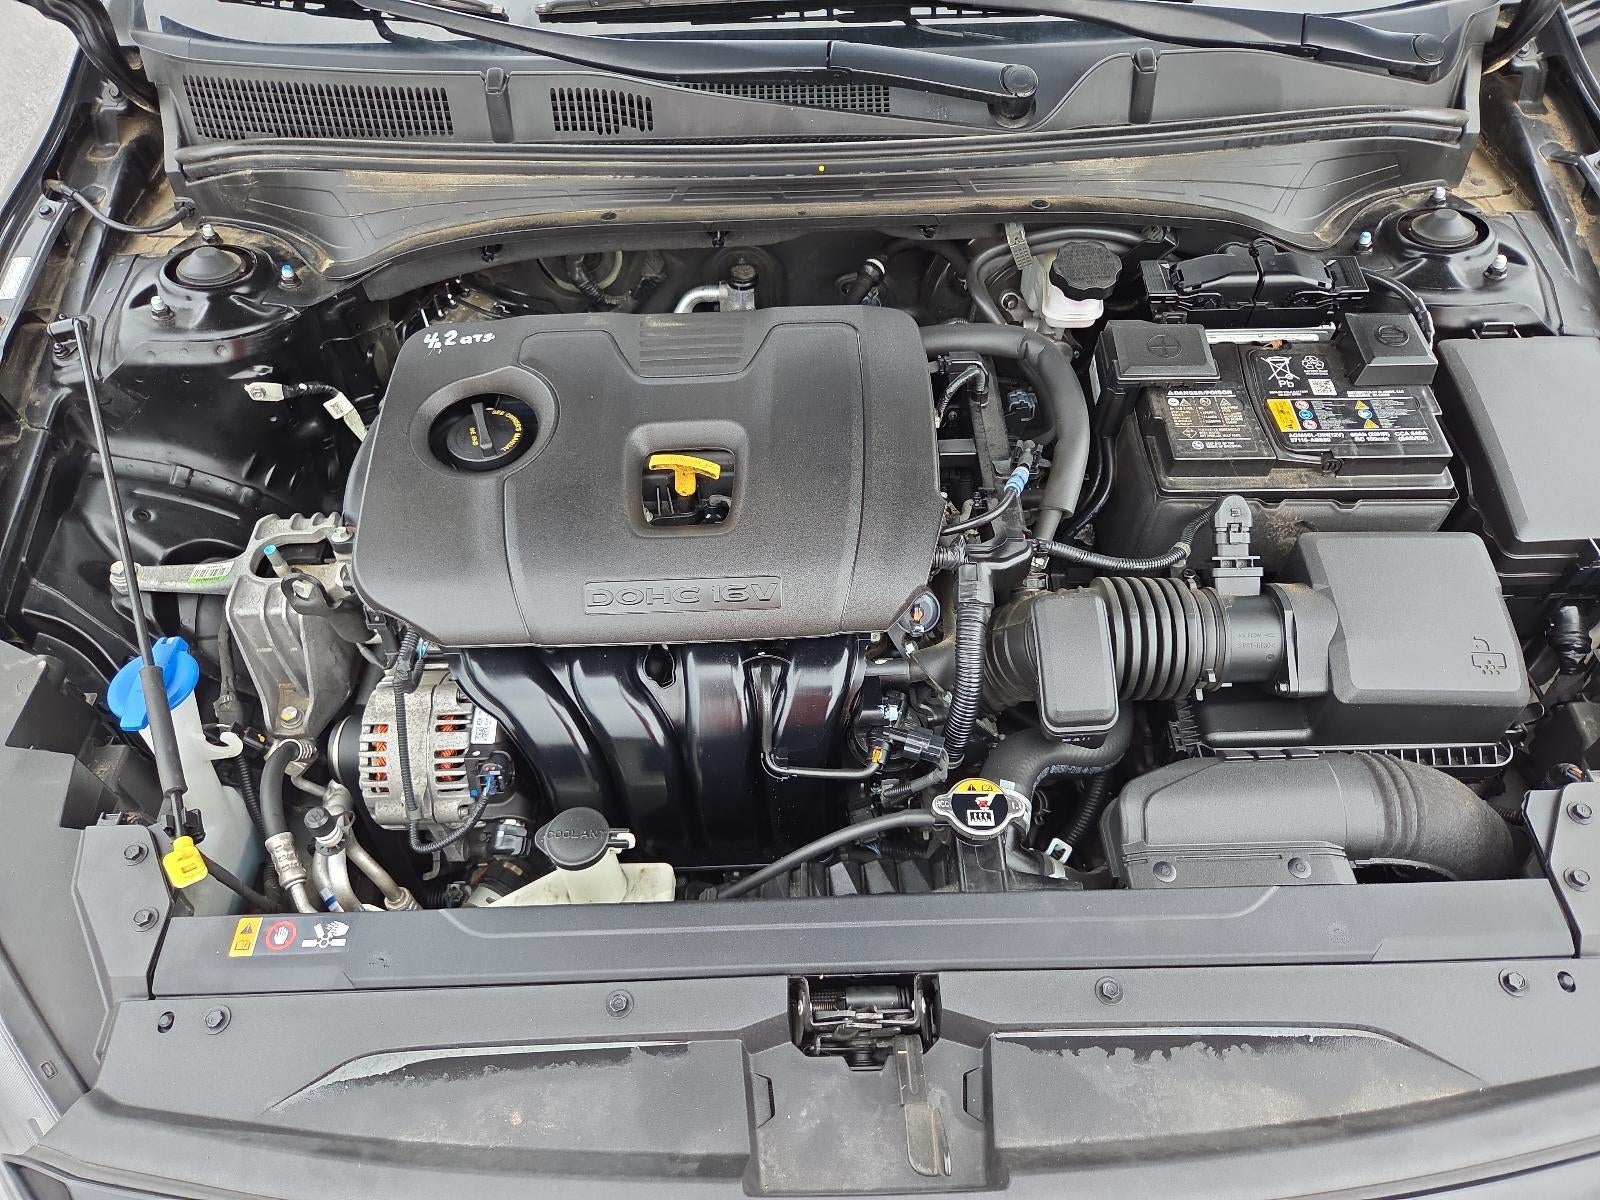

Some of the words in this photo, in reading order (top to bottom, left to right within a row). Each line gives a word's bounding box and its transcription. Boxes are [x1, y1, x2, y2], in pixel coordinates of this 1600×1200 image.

[587, 586, 700, 607] DOHC
[711, 582, 779, 603] 16V
[546, 828, 608, 839] COOLANT
